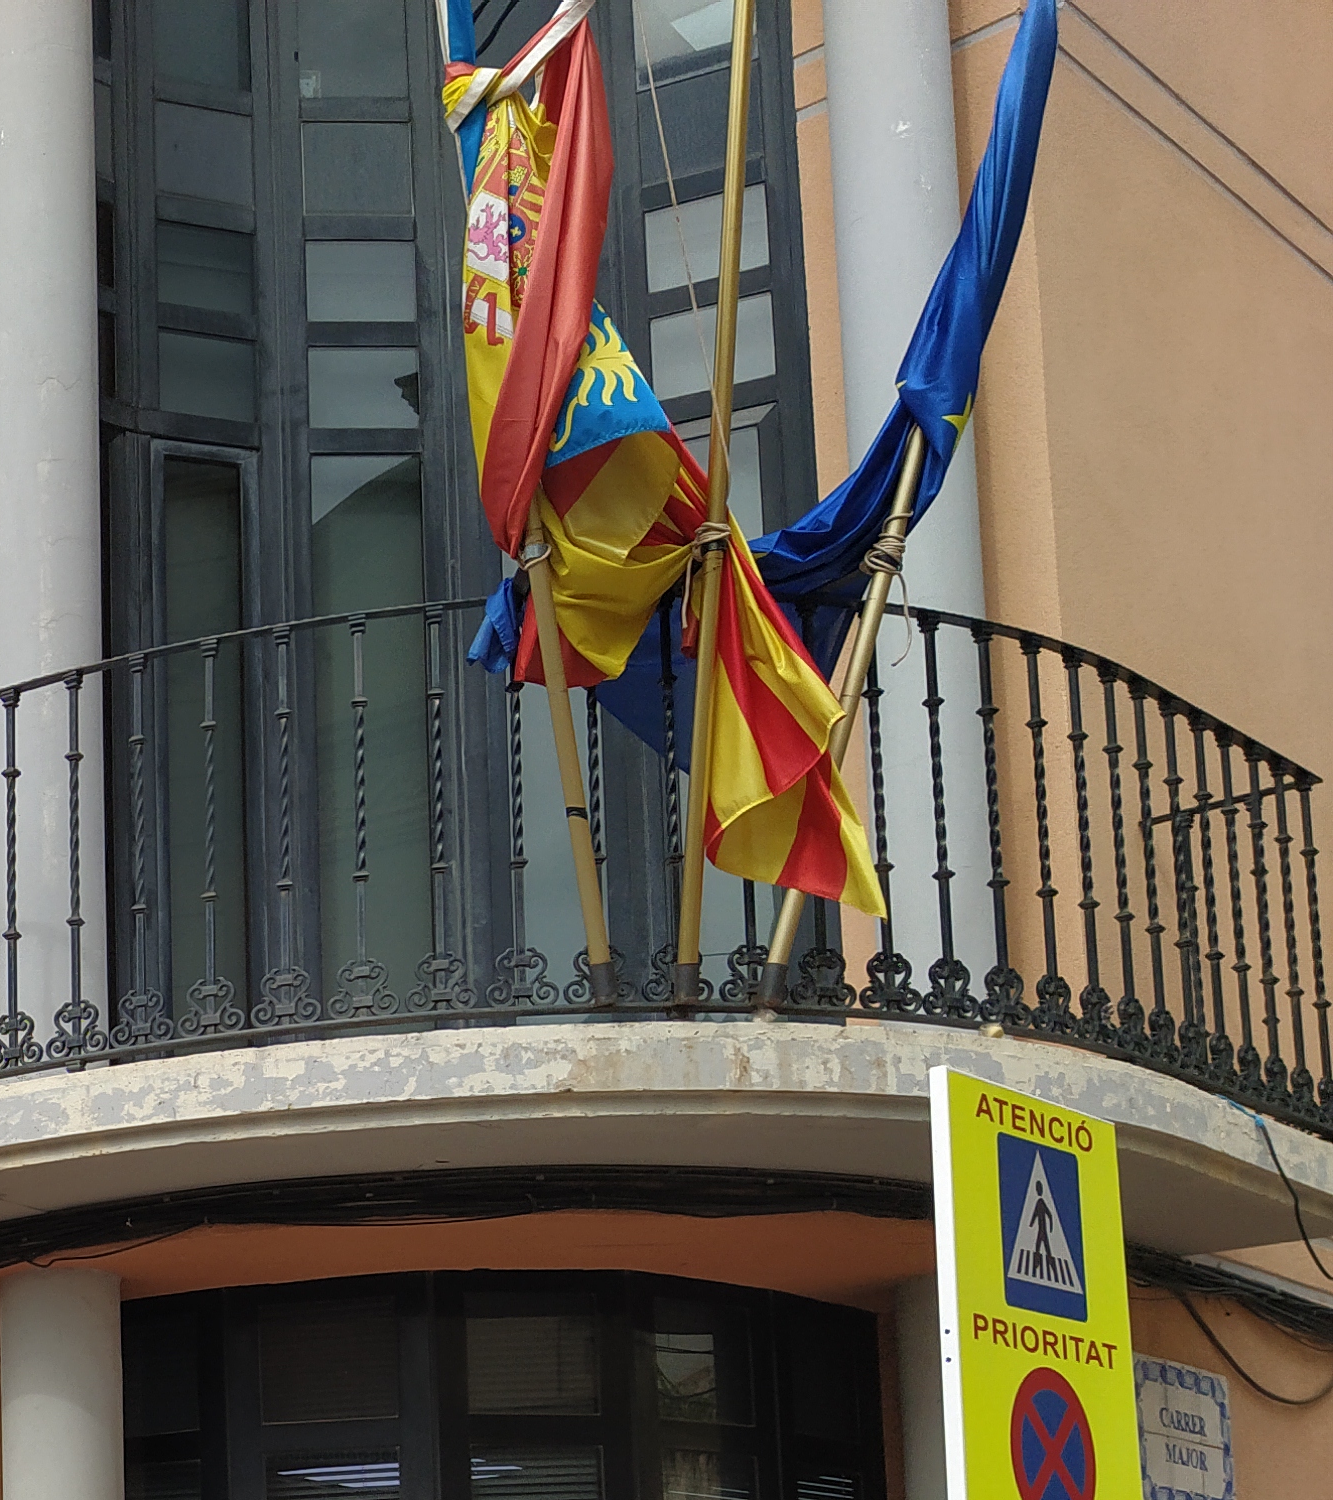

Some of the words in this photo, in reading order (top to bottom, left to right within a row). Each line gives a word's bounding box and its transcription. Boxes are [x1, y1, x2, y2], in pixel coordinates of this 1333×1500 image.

[975, 1092, 1093, 1152] ATENCIÓ
[973, 1312, 1118, 1370] PRIORITAT
[1159, 1407, 1207, 1437] CARRER
[1165, 1442, 1208, 1472] MAJOR
